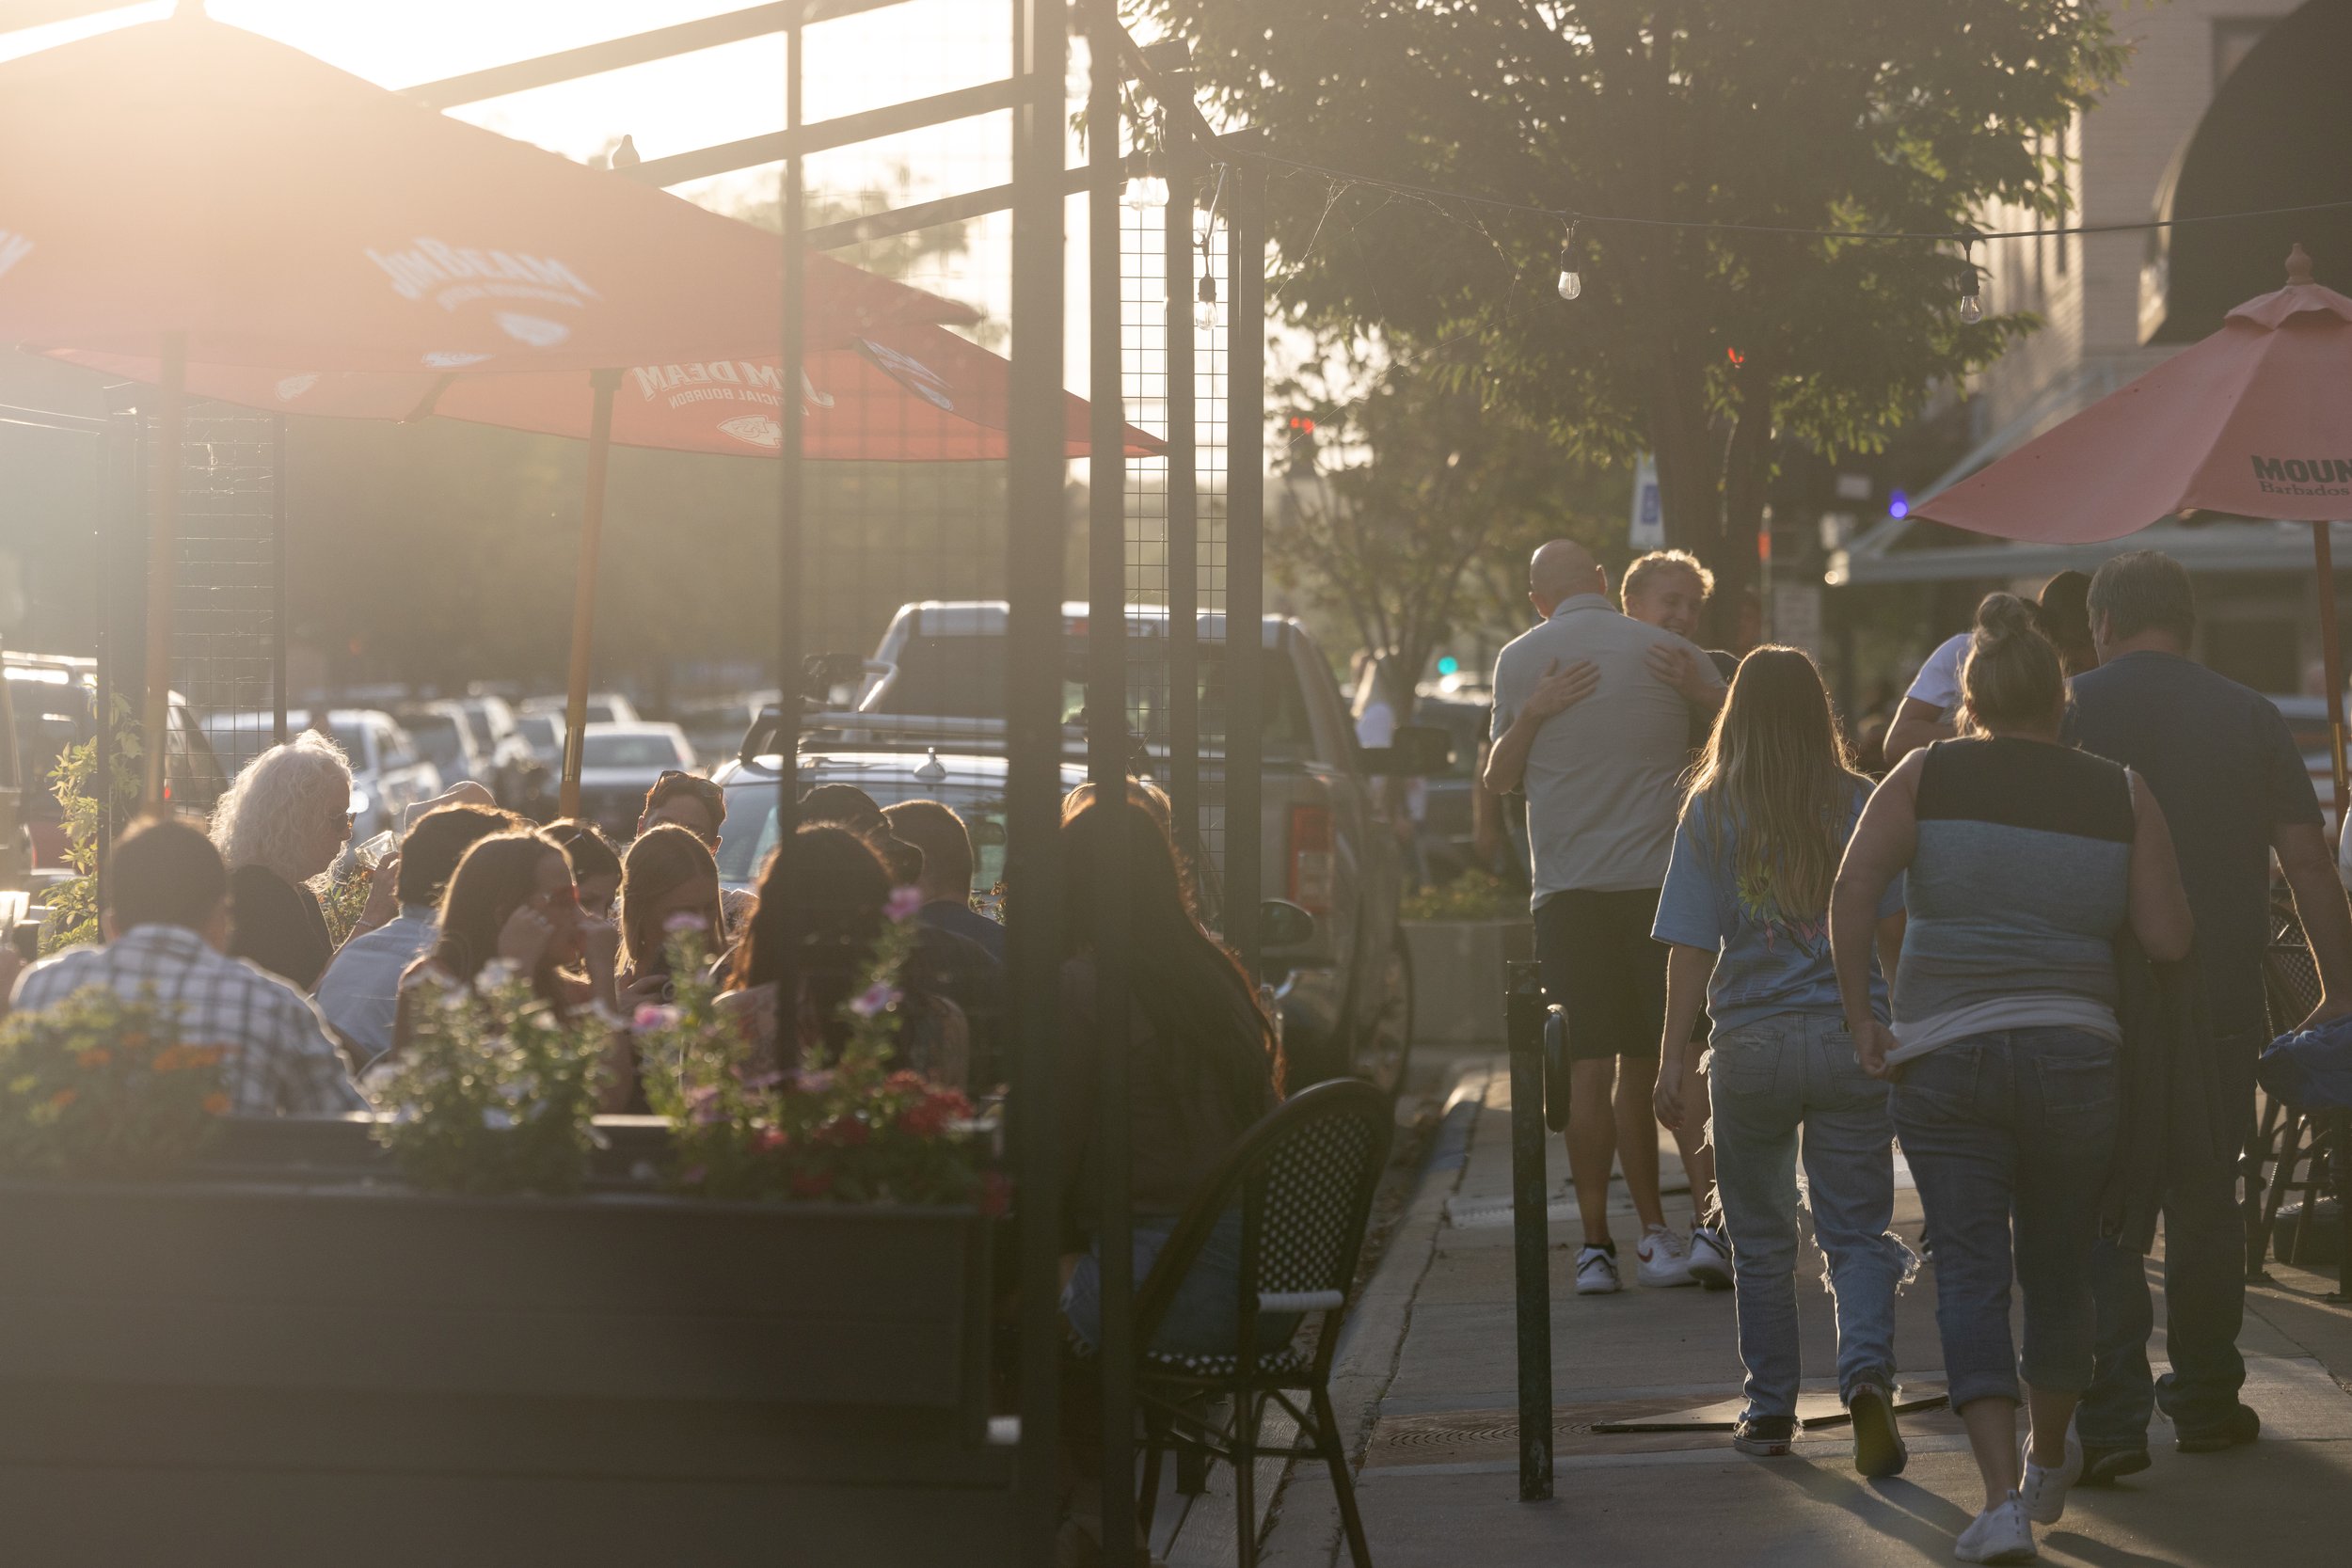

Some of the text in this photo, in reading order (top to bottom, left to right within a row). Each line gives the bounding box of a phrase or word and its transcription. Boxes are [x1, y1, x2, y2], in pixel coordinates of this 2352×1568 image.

[412, 235, 603, 301] BEAM
[2250, 455, 2352, 483] MOUN
[2259, 481, 2350, 496] Barbados
